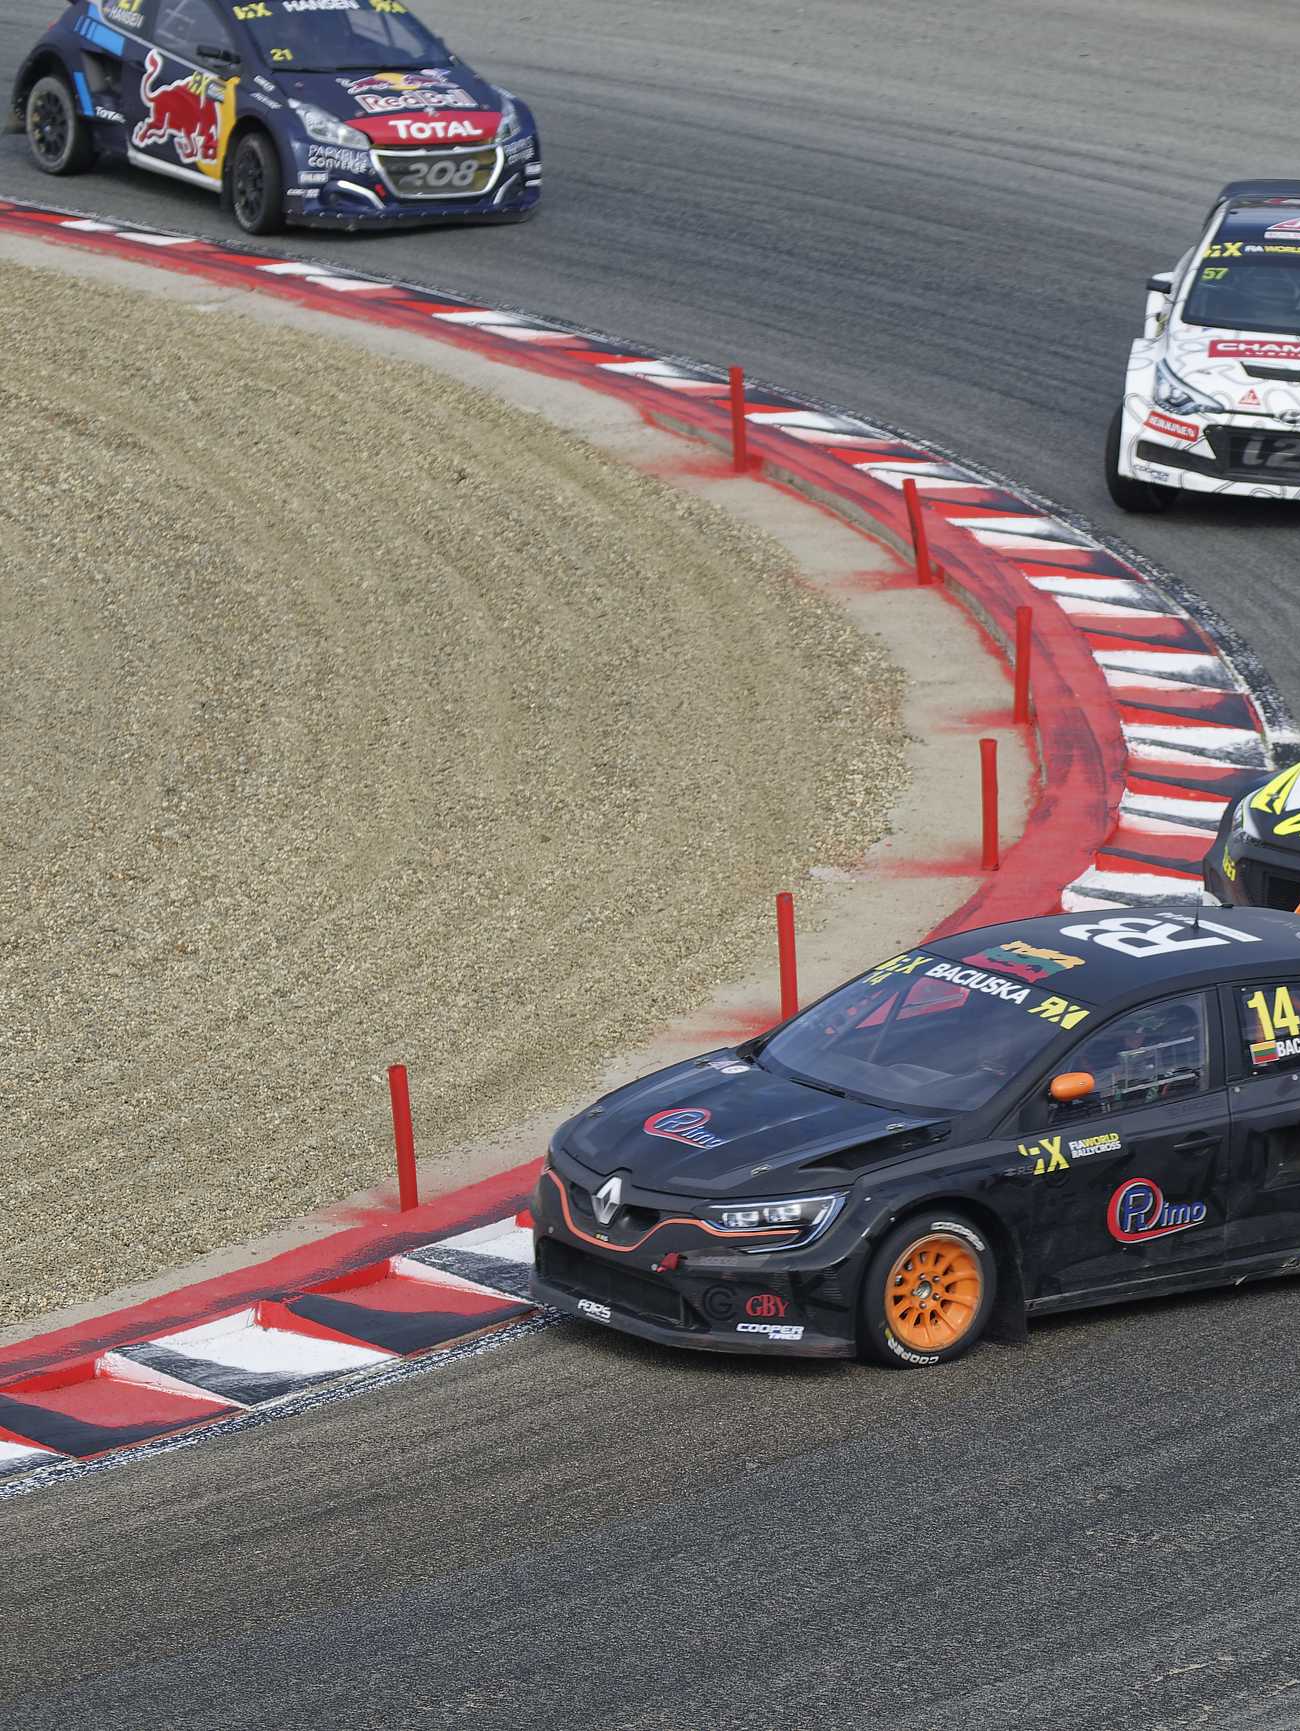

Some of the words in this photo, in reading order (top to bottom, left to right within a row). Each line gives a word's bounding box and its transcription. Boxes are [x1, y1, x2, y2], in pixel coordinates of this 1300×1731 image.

[270, 48, 293, 61] 21
[388, 119, 483, 140] TOTAL
[398, 160, 479, 186] 208
[1202, 267, 1229, 280] 57
[1248, 986, 1300, 1041] 14
[1068, 1139, 1084, 1151] FIA
[1083, 1133, 1120, 1148] WORLD
[1071, 1141, 1121, 1159] RALLYCROSS
[745, 1294, 790, 1317] GBY
[736, 1323, 804, 1335] COOPER
